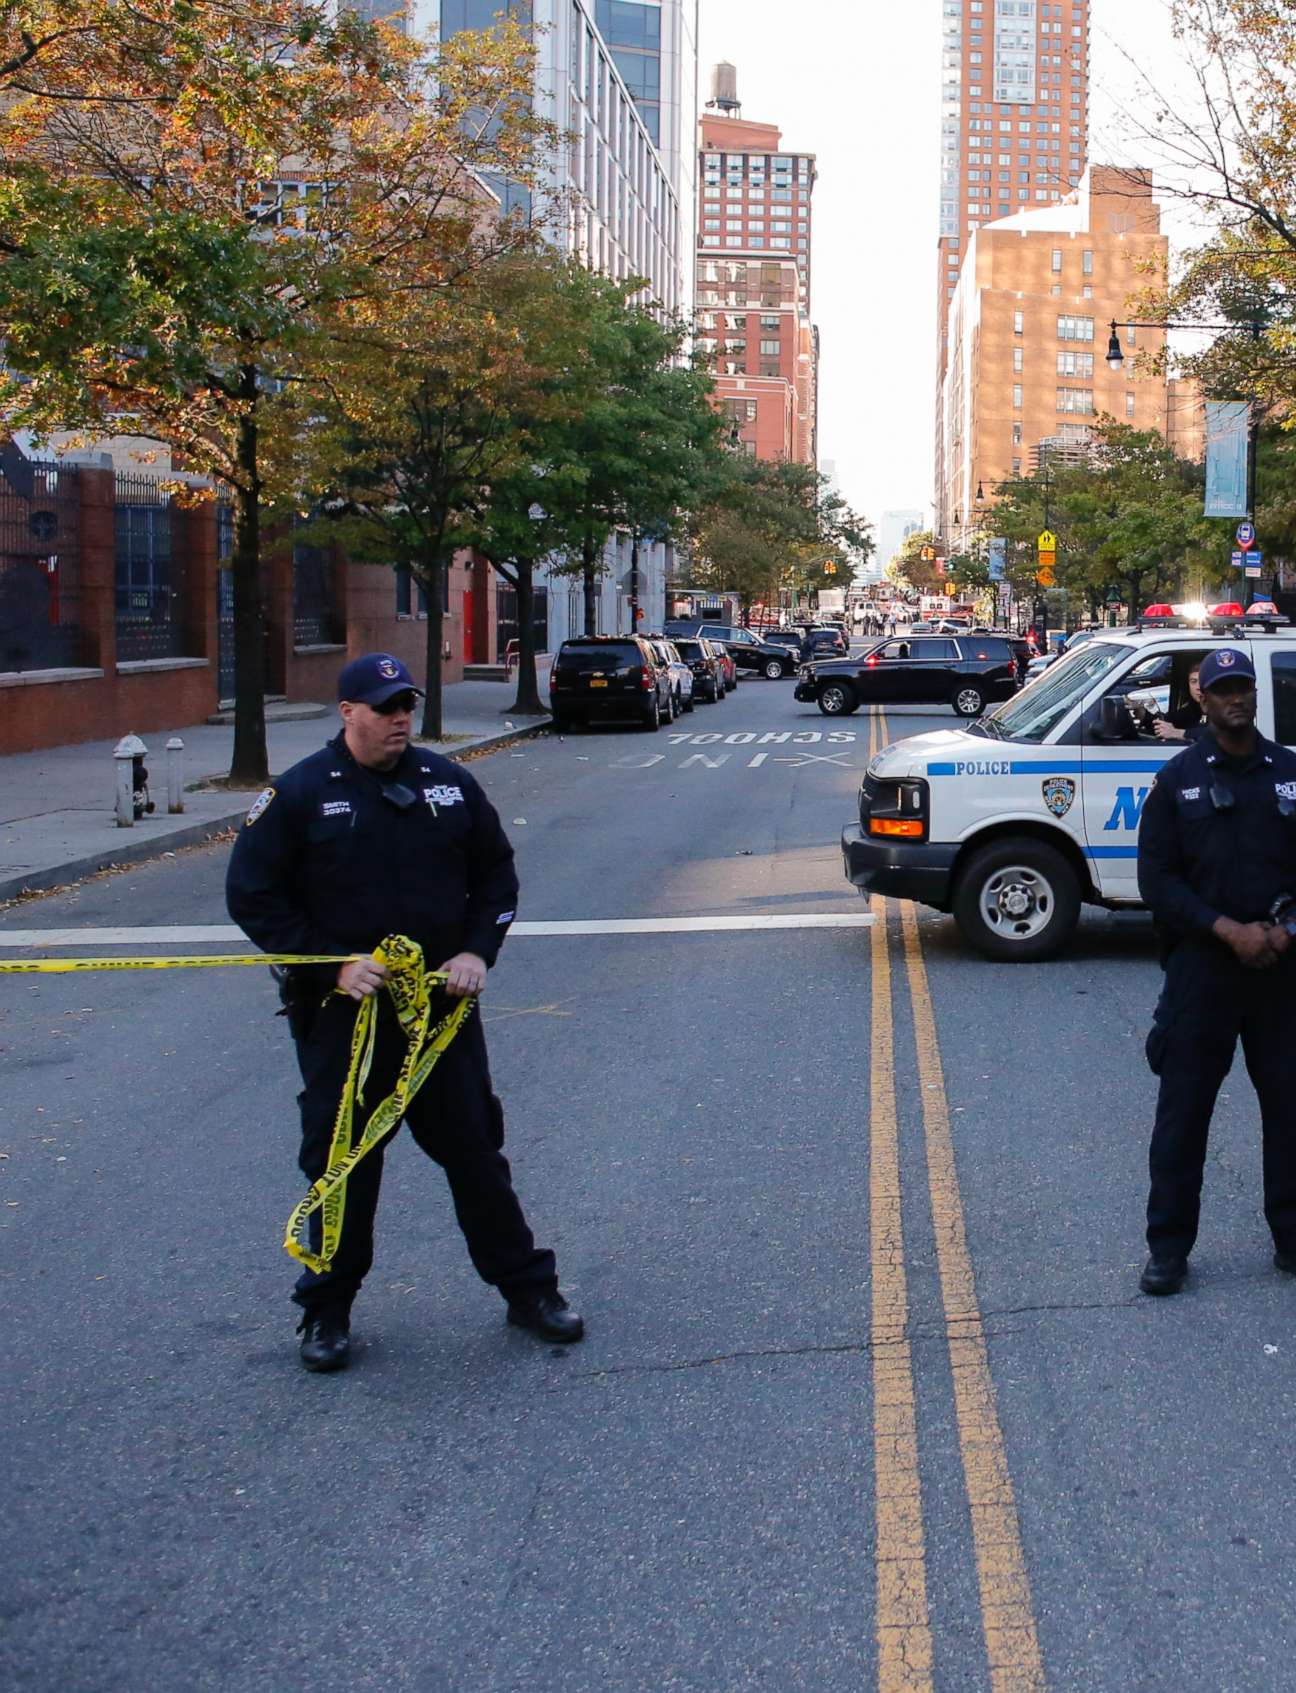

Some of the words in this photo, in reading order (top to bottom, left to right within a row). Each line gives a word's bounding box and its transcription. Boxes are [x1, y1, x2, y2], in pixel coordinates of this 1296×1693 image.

[667, 731, 857, 745] SCHOOL
[956, 761, 1010, 775] POLICE
[423, 786, 463, 798] POLICE
